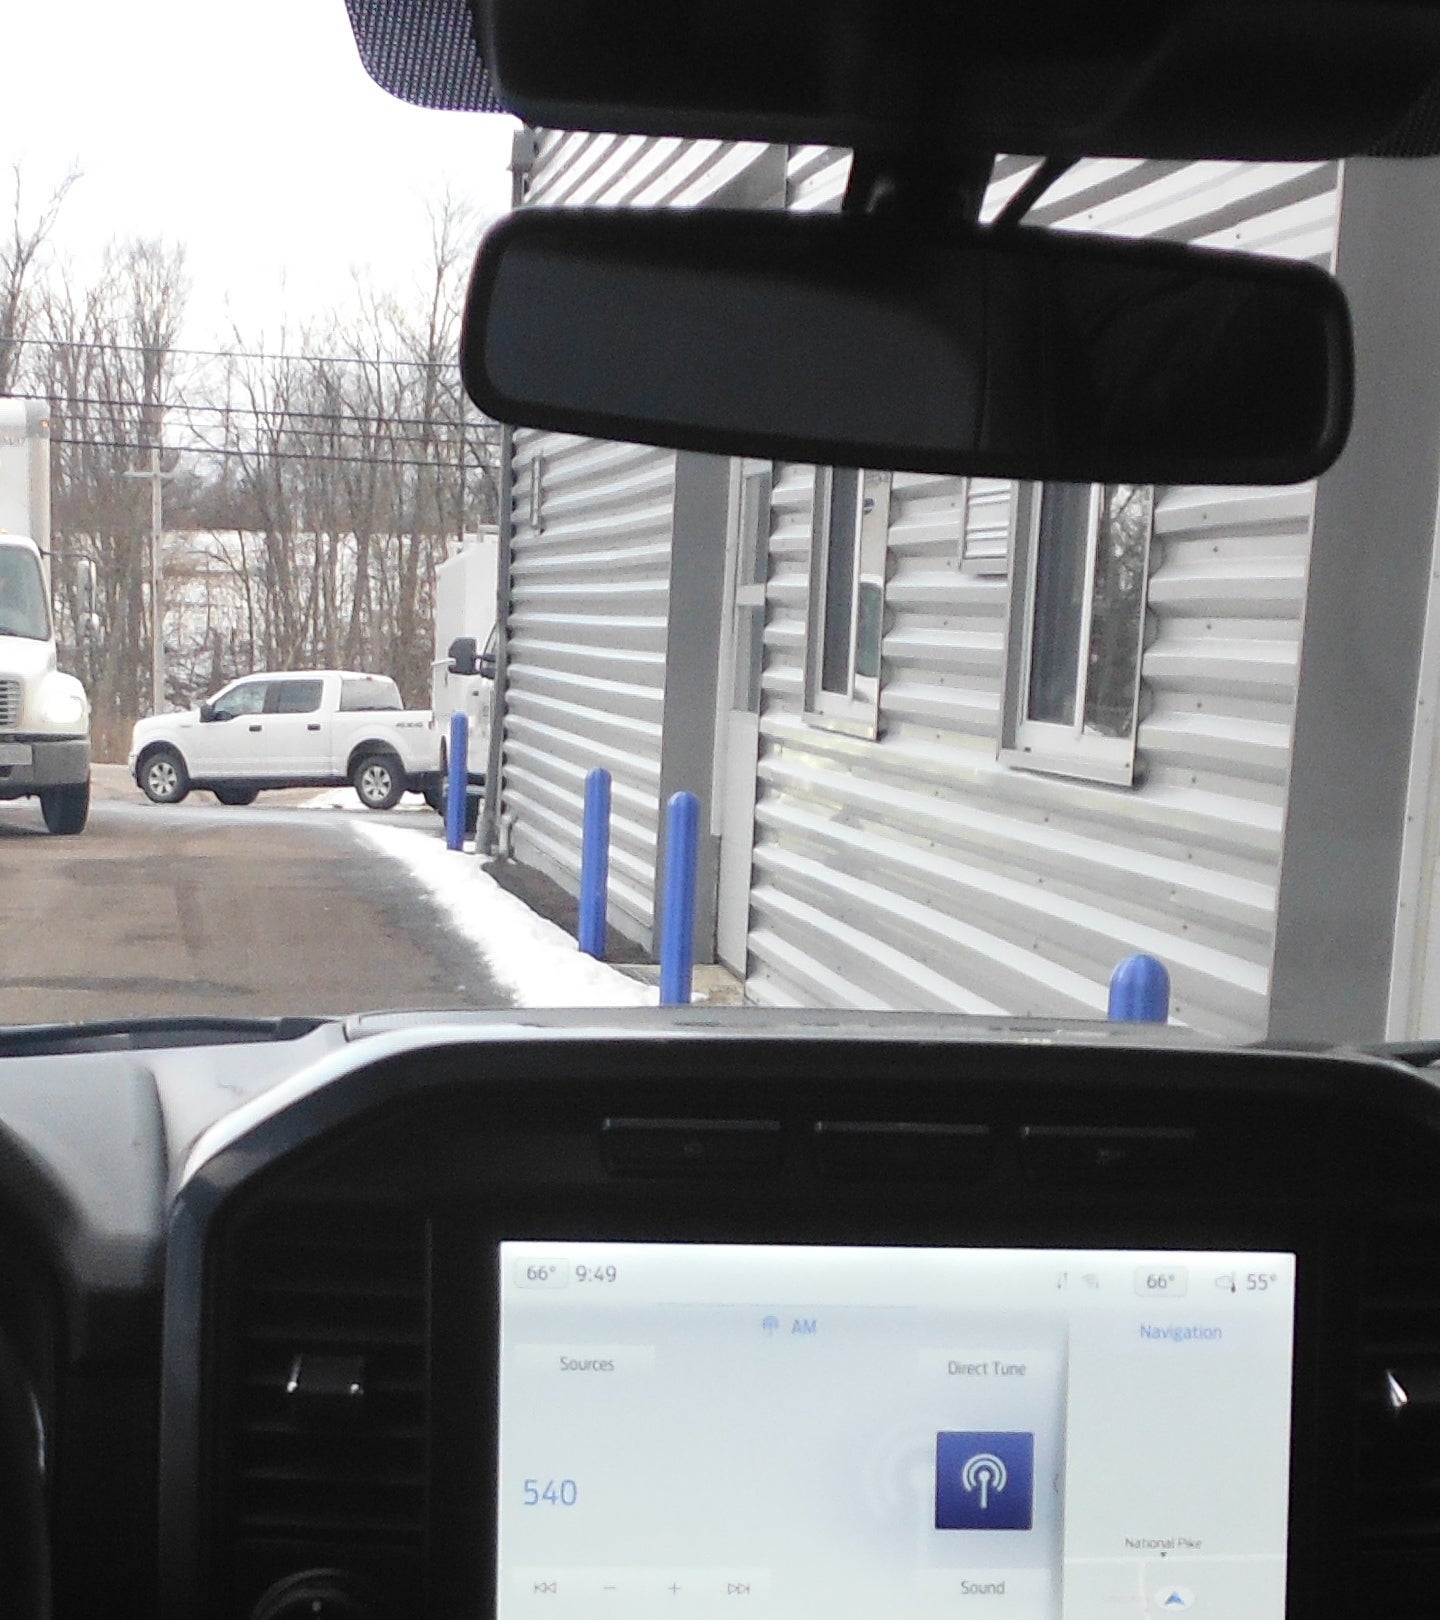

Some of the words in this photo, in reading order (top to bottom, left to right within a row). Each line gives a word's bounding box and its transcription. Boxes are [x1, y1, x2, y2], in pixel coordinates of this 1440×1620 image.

[574, 1264, 618, 1283] 9:49
[1246, 1273, 1277, 1290] 55°
[790, 1318, 818, 1335] AM
[1139, 1324, 1223, 1344] Navigation
[559, 1355, 616, 1373] Sources
[947, 1360, 988, 1376] Direct
[992, 1361, 1027, 1377] Tune
[523, 1479, 578, 1507] 540
[1124, 1537, 1175, 1550] National
[1177, 1538, 1203, 1551] Pike
[960, 1580, 1006, 1595] Sound
